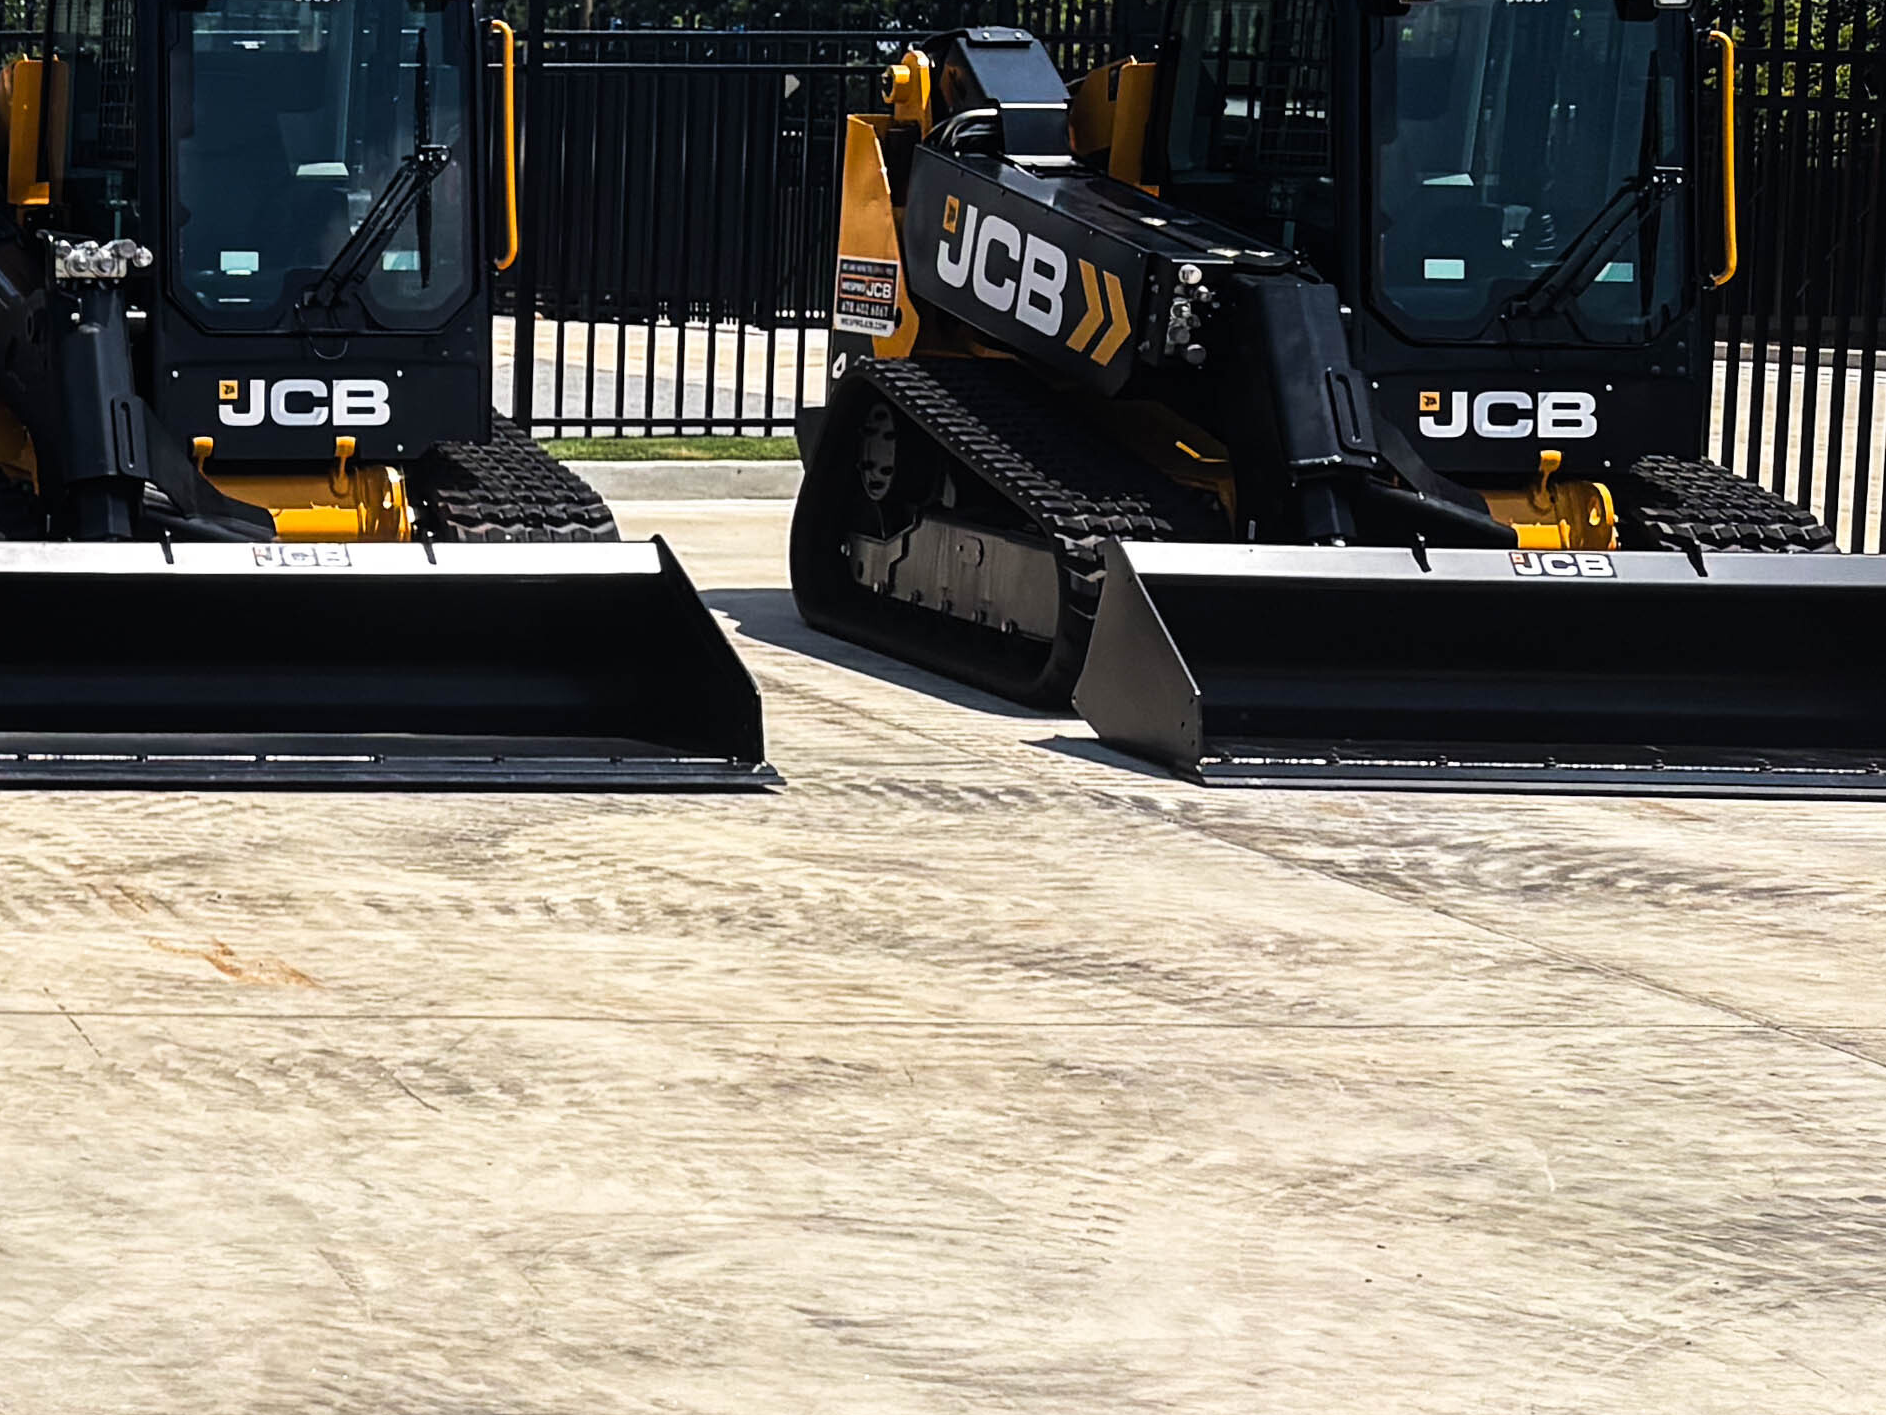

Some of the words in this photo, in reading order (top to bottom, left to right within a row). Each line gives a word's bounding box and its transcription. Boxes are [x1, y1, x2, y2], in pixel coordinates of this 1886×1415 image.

[937, 204, 1068, 336] JCB
[866, 282, 892, 299] JCB
[219, 379, 390, 426] JCB
[1419, 391, 1597, 438] JCB
[254, 544, 351, 567] JCB
[1515, 552, 1614, 577] JCB
